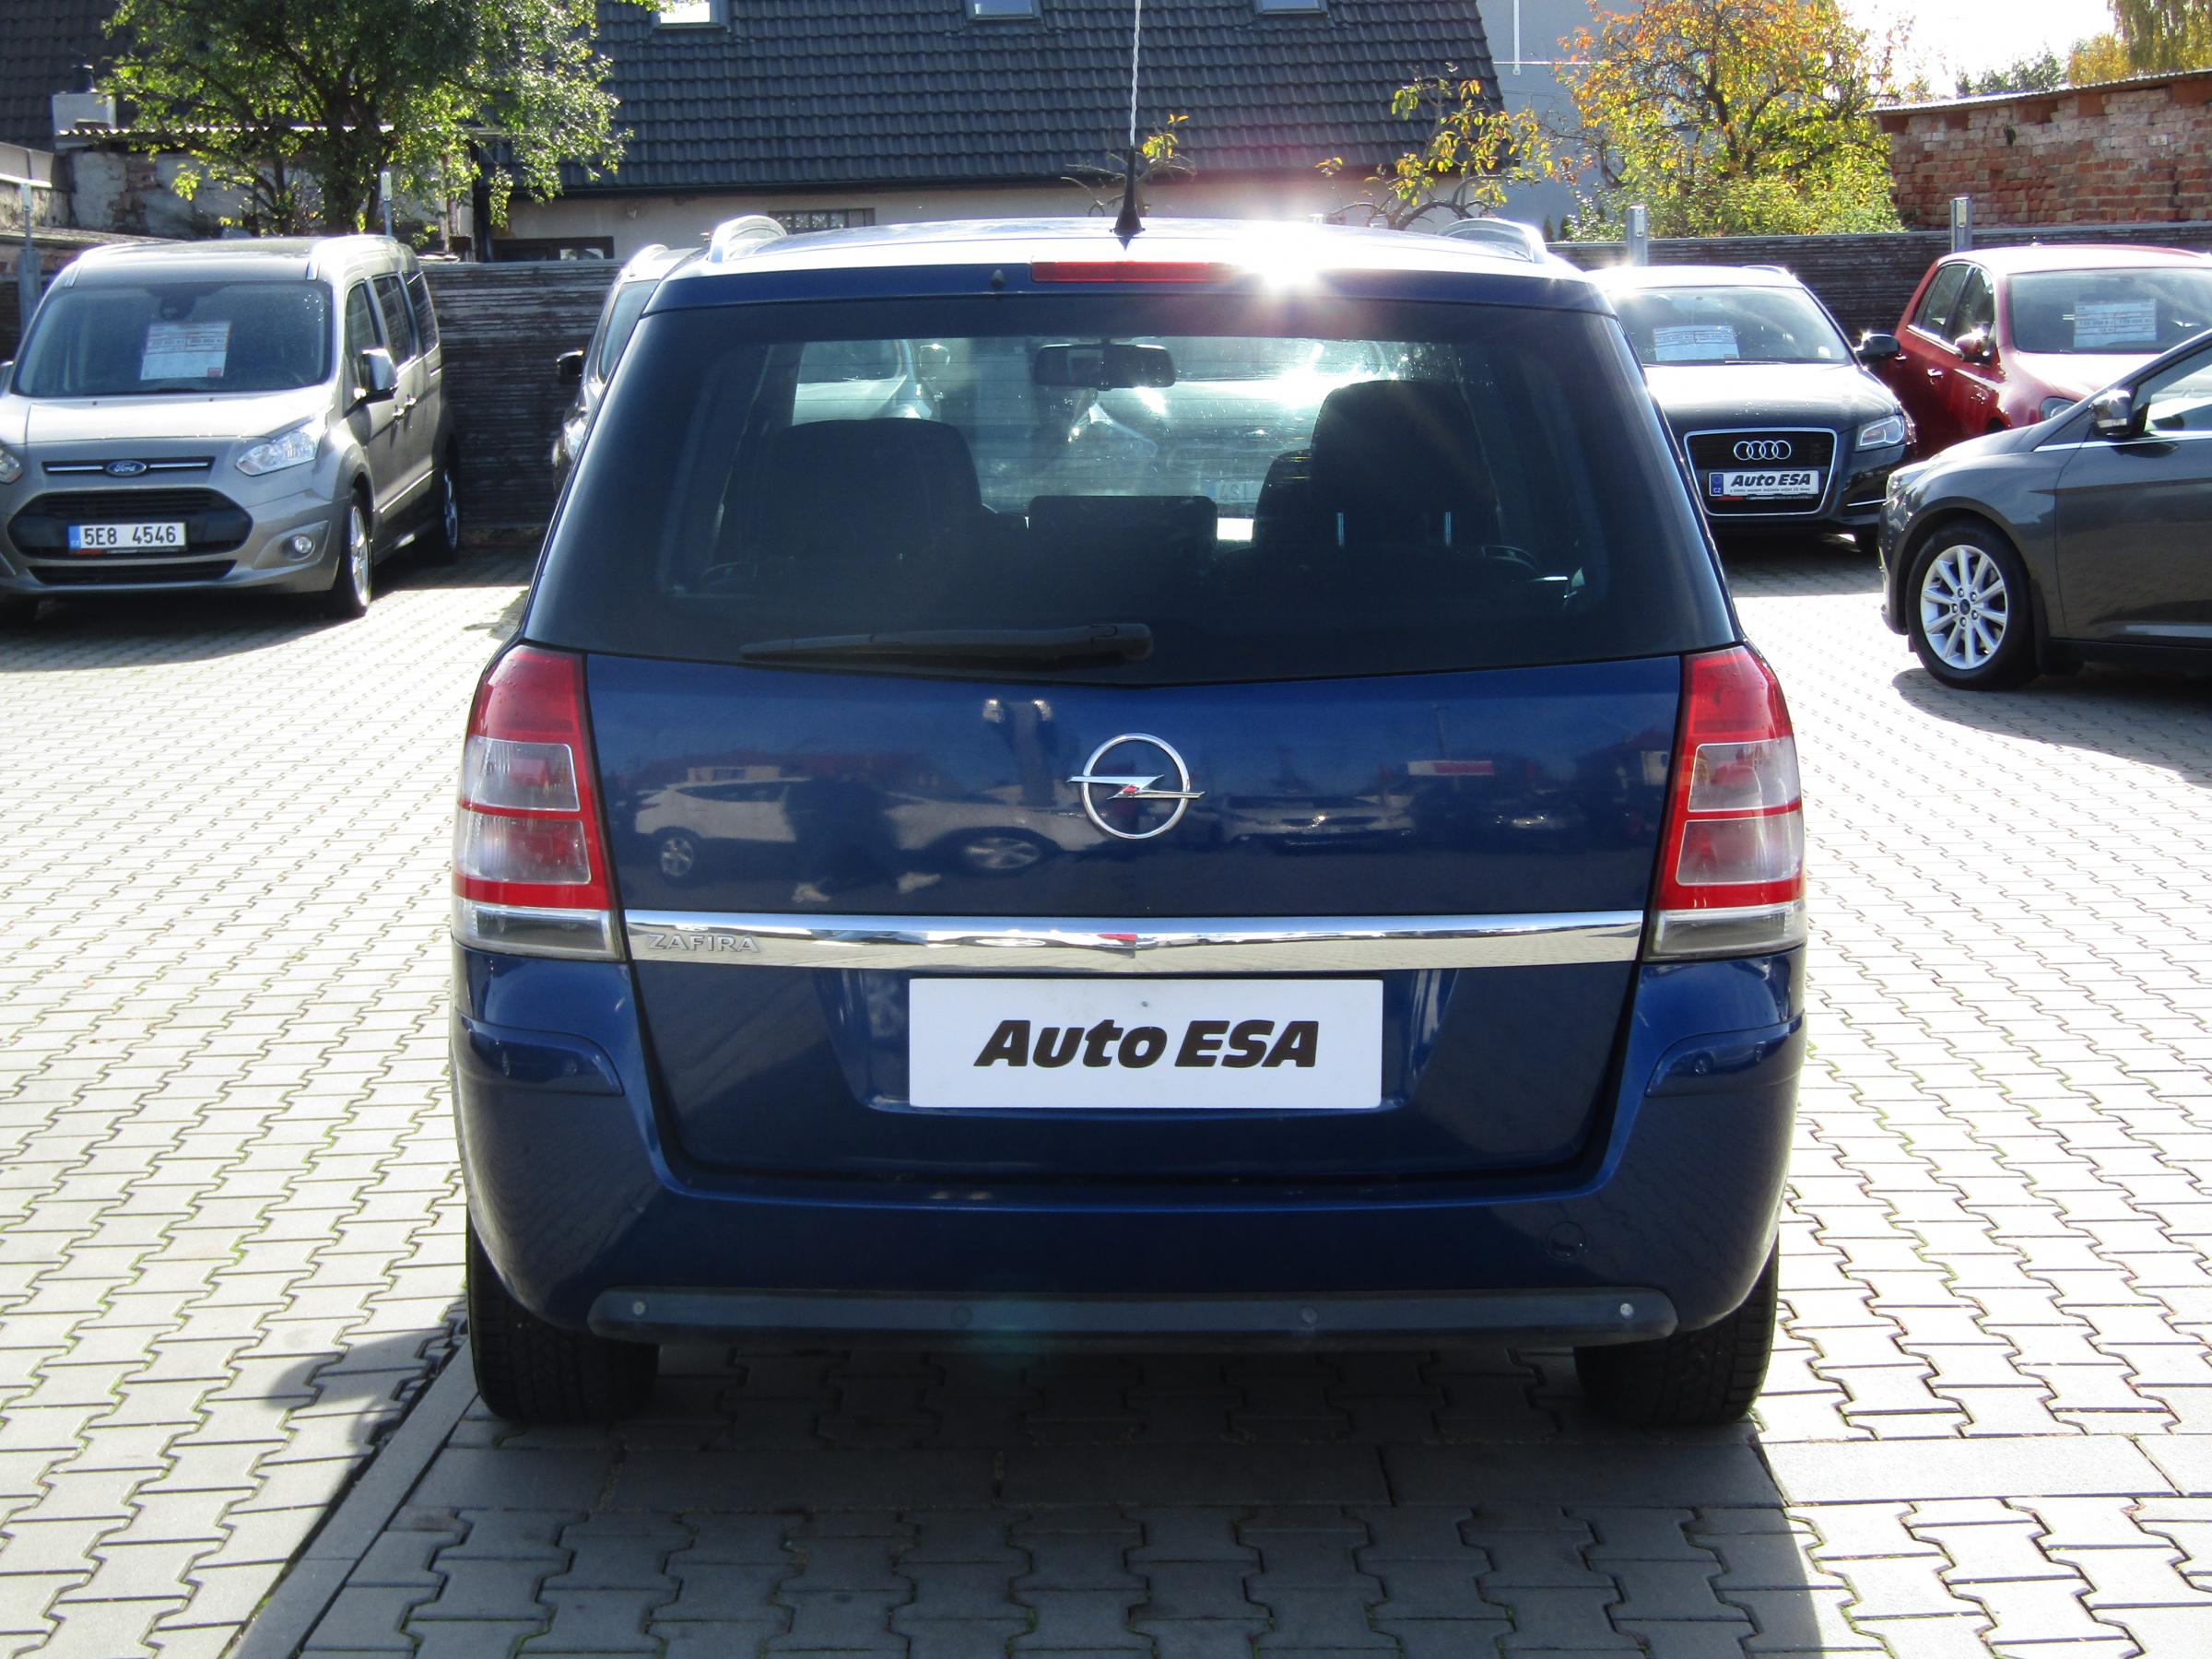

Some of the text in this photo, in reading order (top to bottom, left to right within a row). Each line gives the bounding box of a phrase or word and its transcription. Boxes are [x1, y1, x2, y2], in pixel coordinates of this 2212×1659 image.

[113, 463, 135, 473] Ford
[1731, 473, 1811, 487] Auto ESA
[84, 525, 176, 546] 5E8 4546
[648, 933, 760, 953] ZAFIRA
[973, 1019, 1319, 1068] Auto ESA
